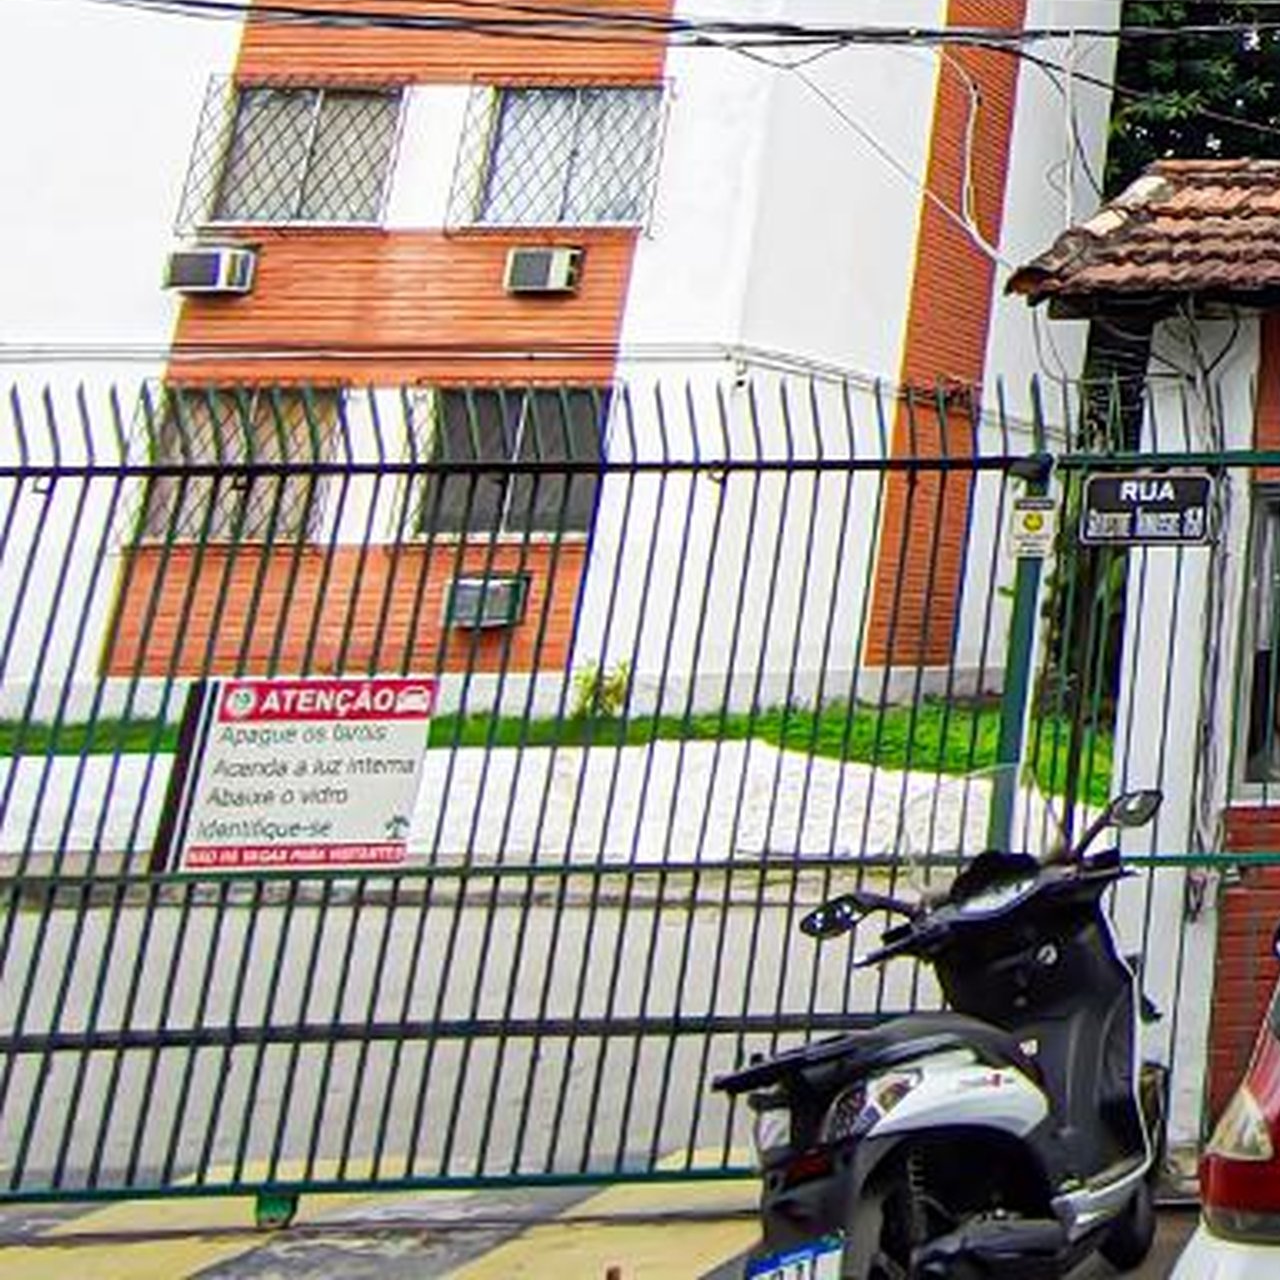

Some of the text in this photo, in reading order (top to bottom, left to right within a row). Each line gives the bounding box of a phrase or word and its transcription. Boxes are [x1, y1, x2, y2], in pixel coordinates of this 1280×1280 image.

[1121, 480, 1175, 501] RUA
[260, 683, 394, 717] ATENÇÃO
[219, 725, 298, 747] Apague
[303, 728, 327, 743] os
[213, 757, 415, 777] Acenda a luz interna
[206, 787, 348, 806] Abaixe o vidro
